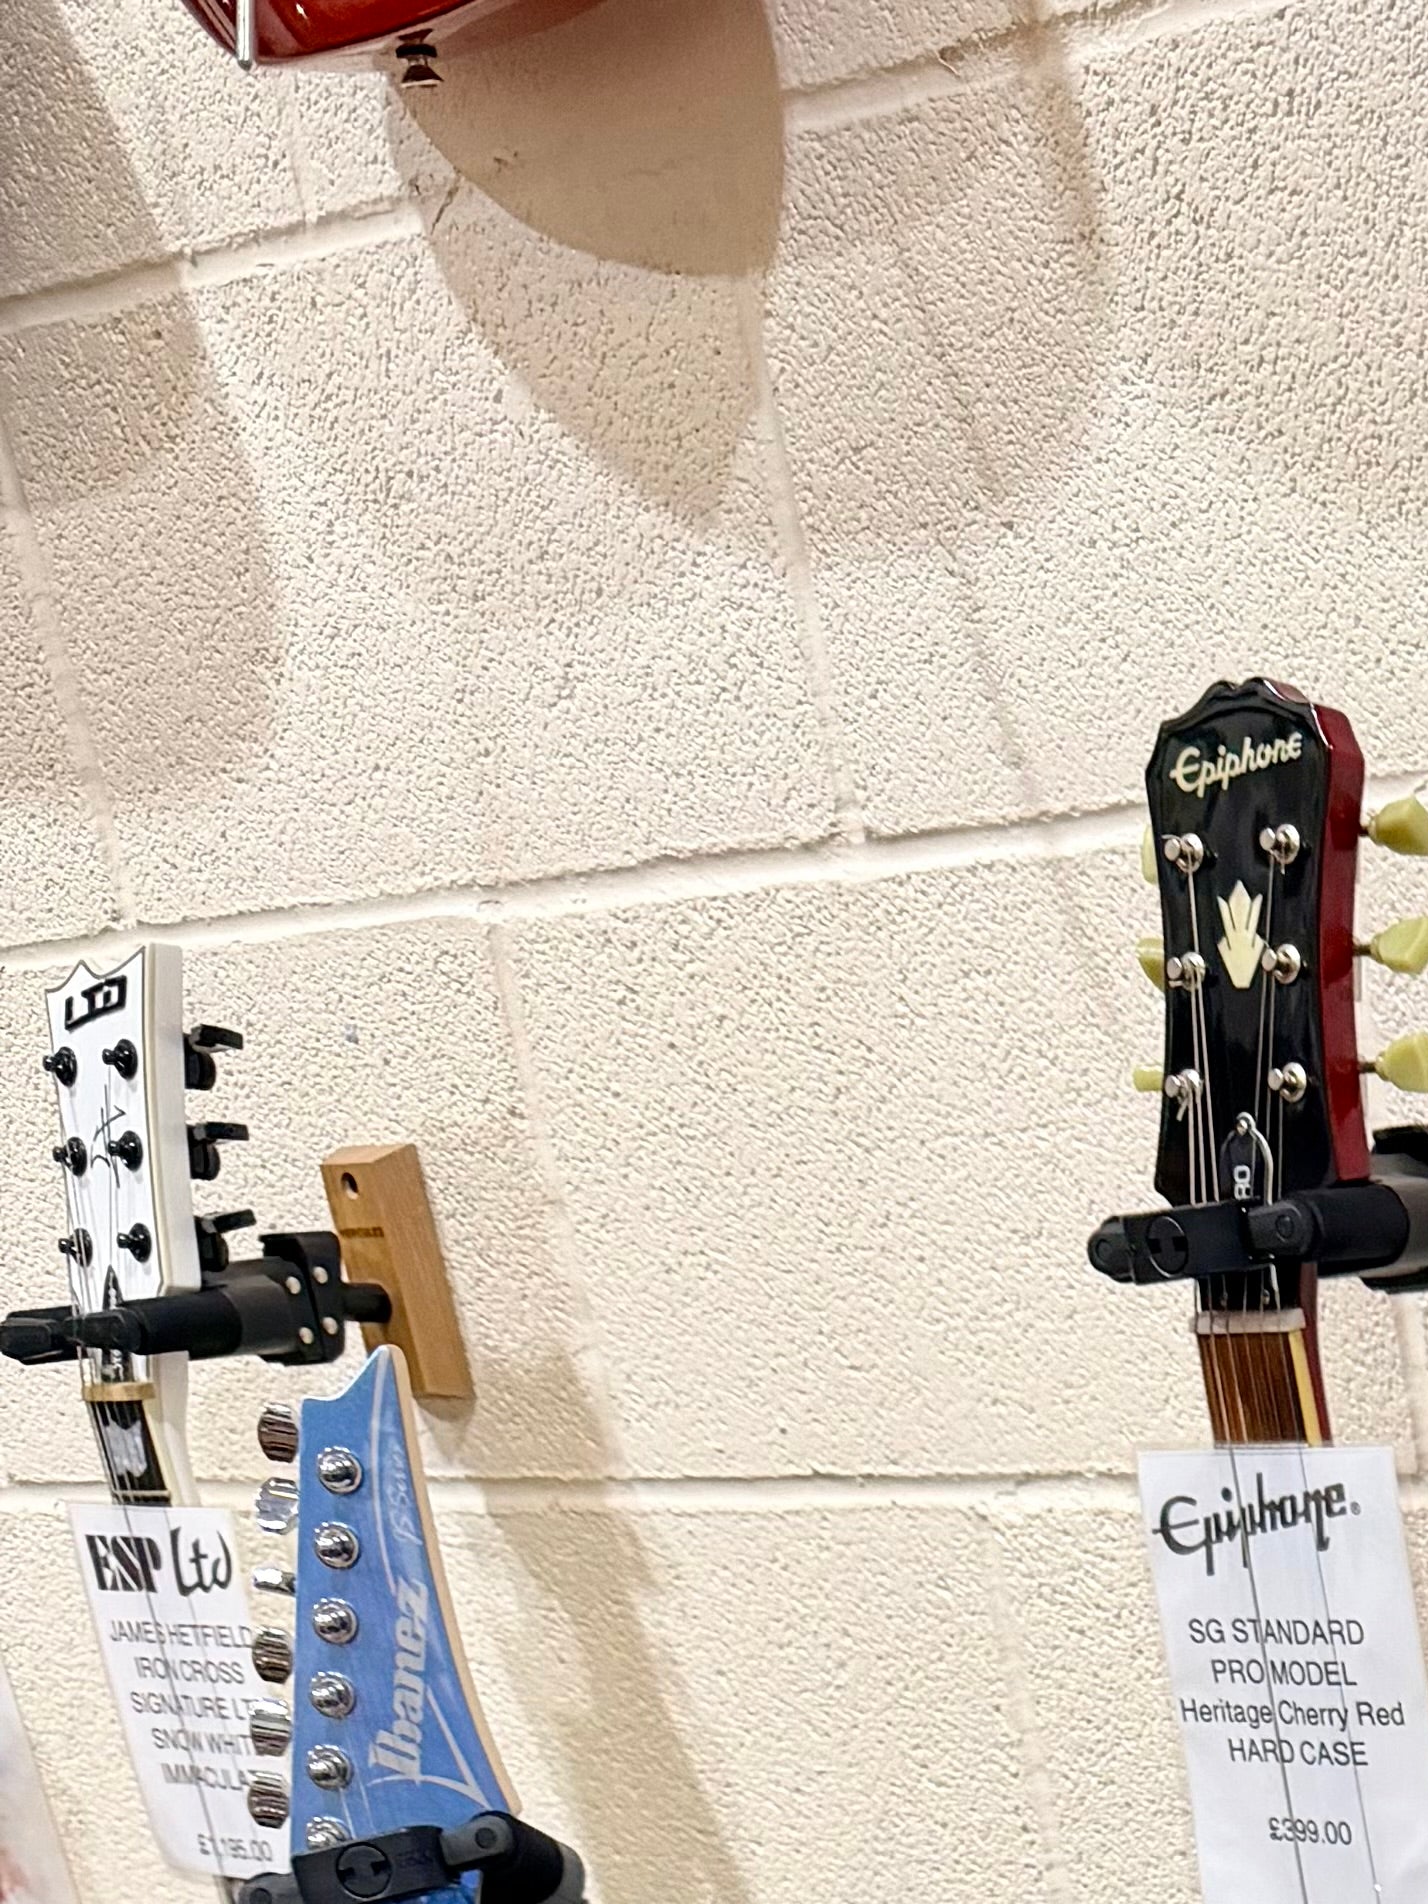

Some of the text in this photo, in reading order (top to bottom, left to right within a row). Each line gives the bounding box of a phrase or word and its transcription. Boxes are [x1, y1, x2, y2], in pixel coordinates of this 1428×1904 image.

[1169, 731, 1303, 797] Epiphone
[1152, 1472, 1347, 1577] Epiphone
[85, 1534, 162, 1593] ESP
[110, 1620, 166, 1645] JAMES
[1188, 1618, 1365, 1647] SG STANDARD
[134, 1657, 245, 1685] IRON CROSS
[369, 1576, 429, 1786] Ibanez
[1211, 1659, 1358, 1688] PRO MODEL
[130, 1692, 230, 1720] SIGNATURE
[1181, 1699, 1405, 1732] Heritage Cherry Red
[151, 1728, 201, 1753] SNOW
[1228, 1738, 1369, 1767] HARD CASE
[1269, 1816, 1353, 1846] £399.00
